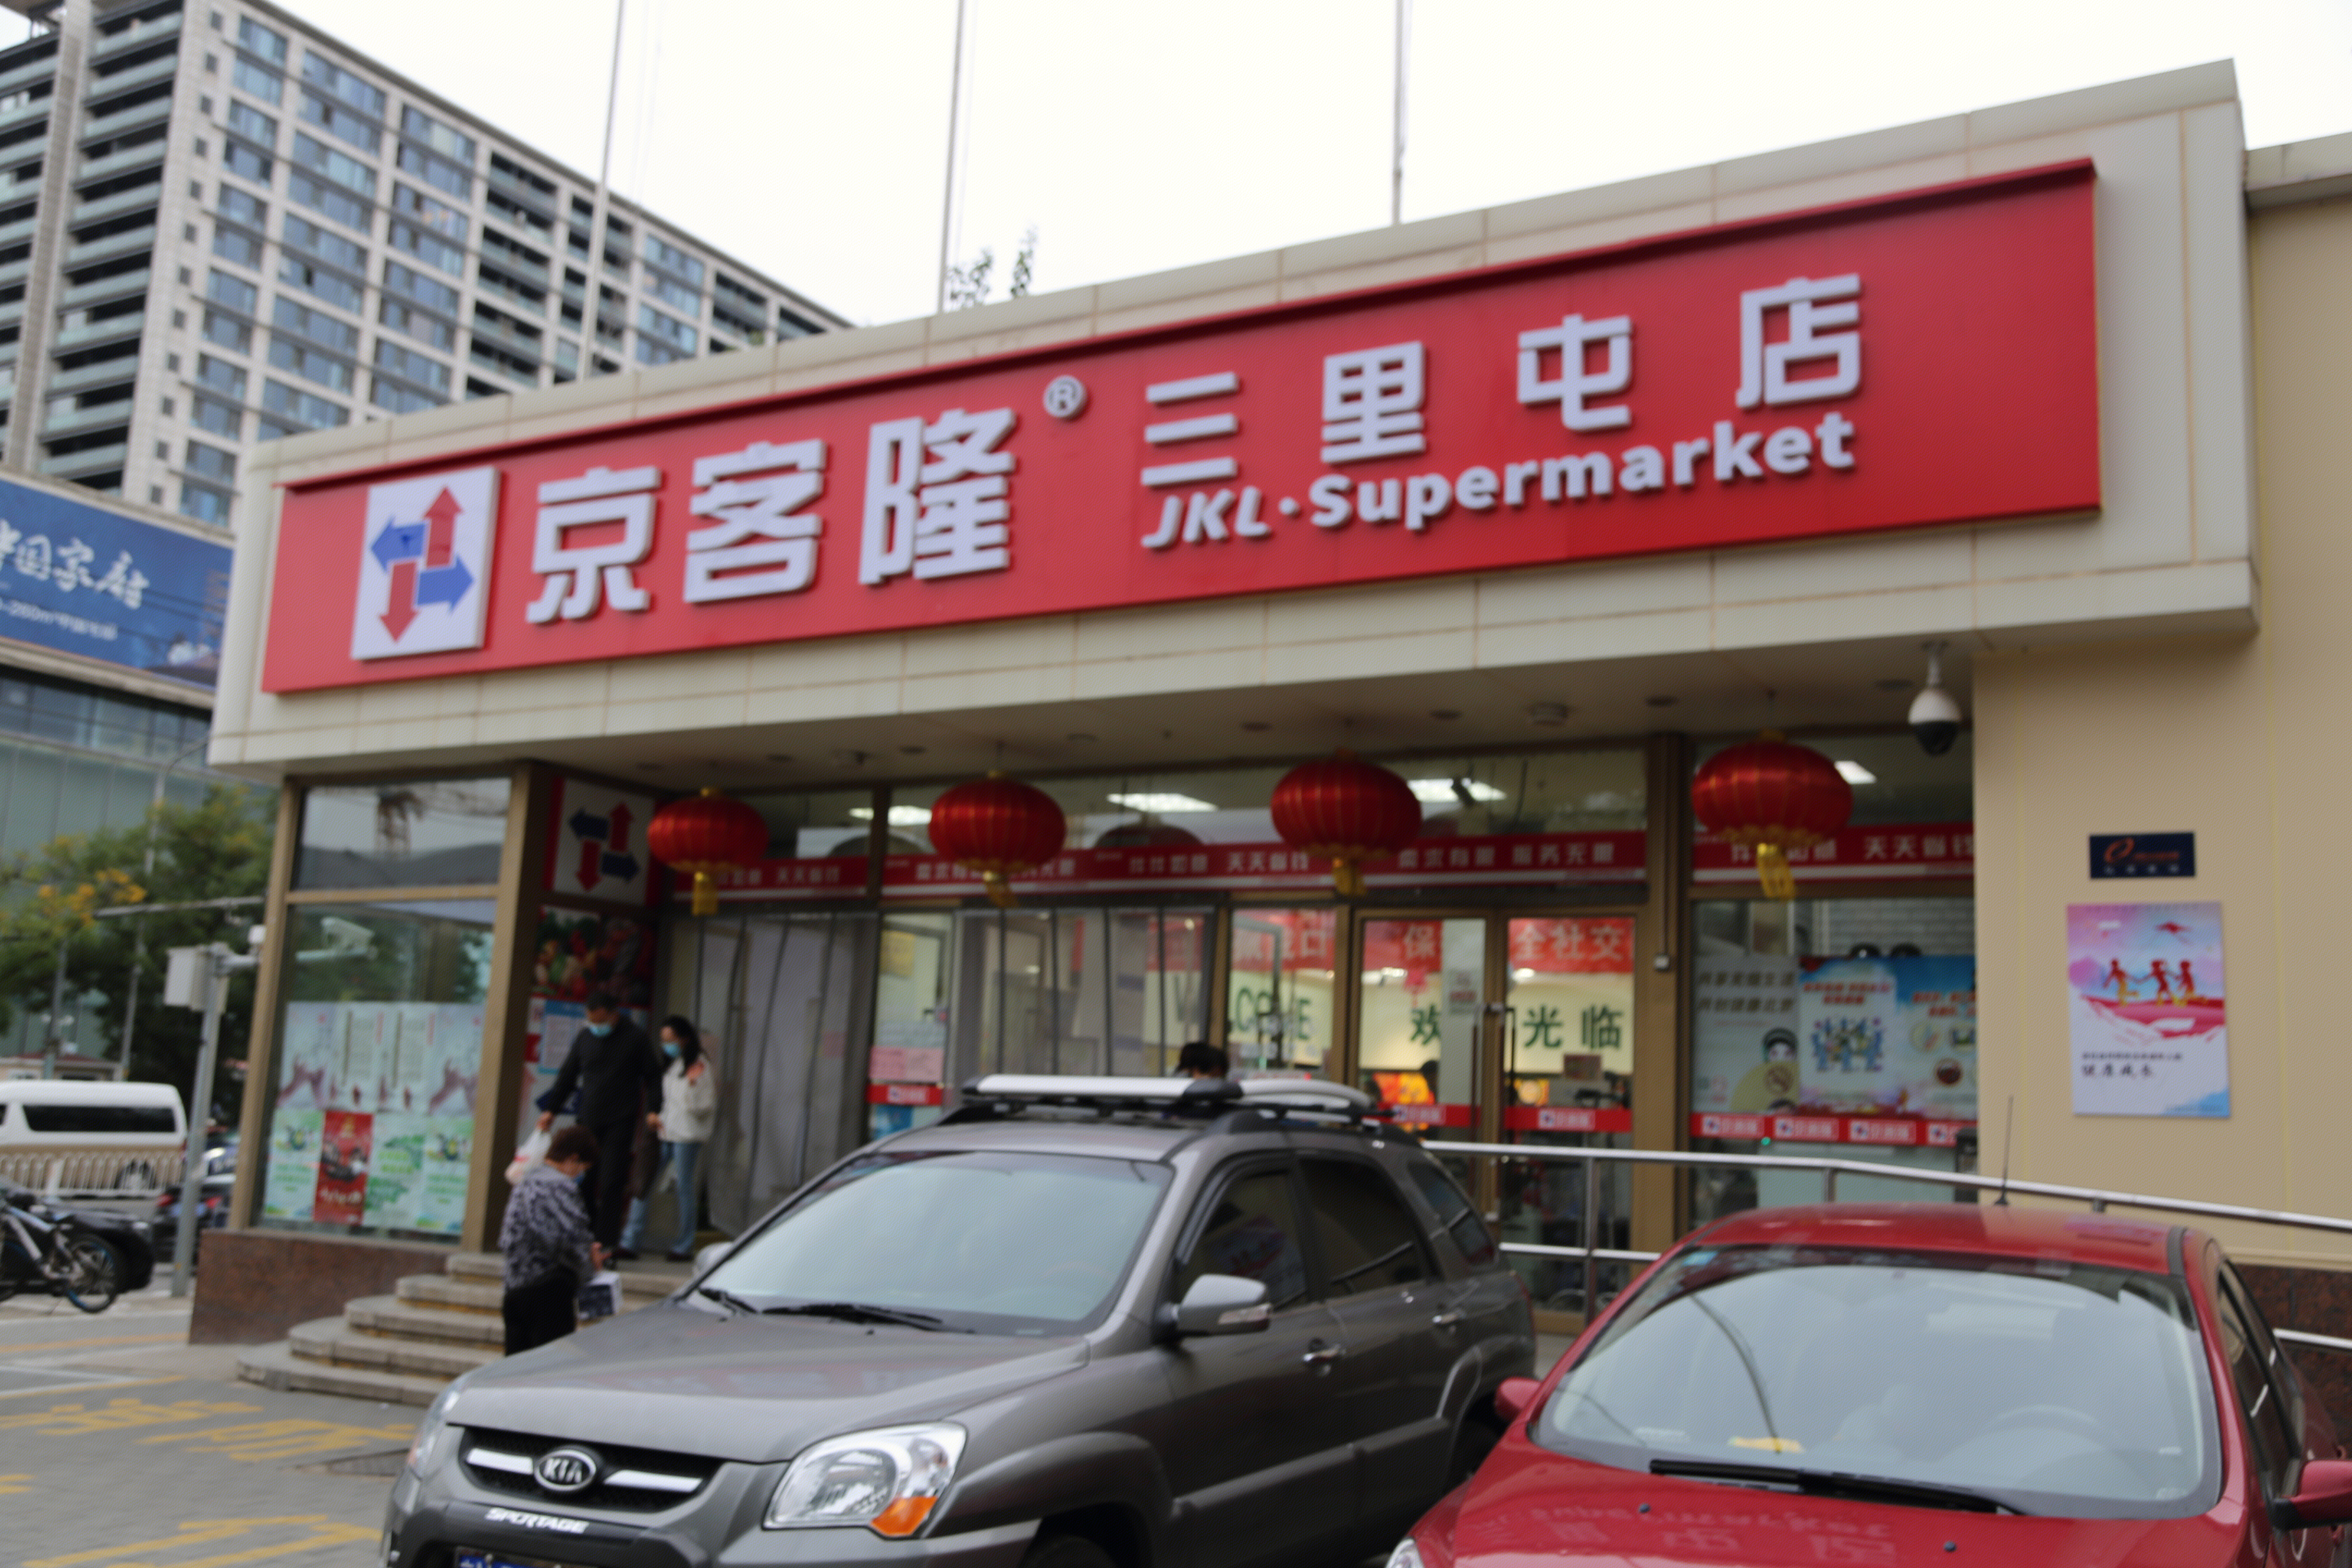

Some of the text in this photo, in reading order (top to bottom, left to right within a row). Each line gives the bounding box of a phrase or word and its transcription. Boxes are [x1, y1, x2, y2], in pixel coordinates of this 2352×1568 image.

[1141, 274, 1861, 486] 三里屯店
[526, 407, 1016, 623] 京客隆
[1514, 923, 1625, 962] 全社交
[1522, 1004, 1626, 1050] 光临
[543, 1457, 584, 1484] KIA
